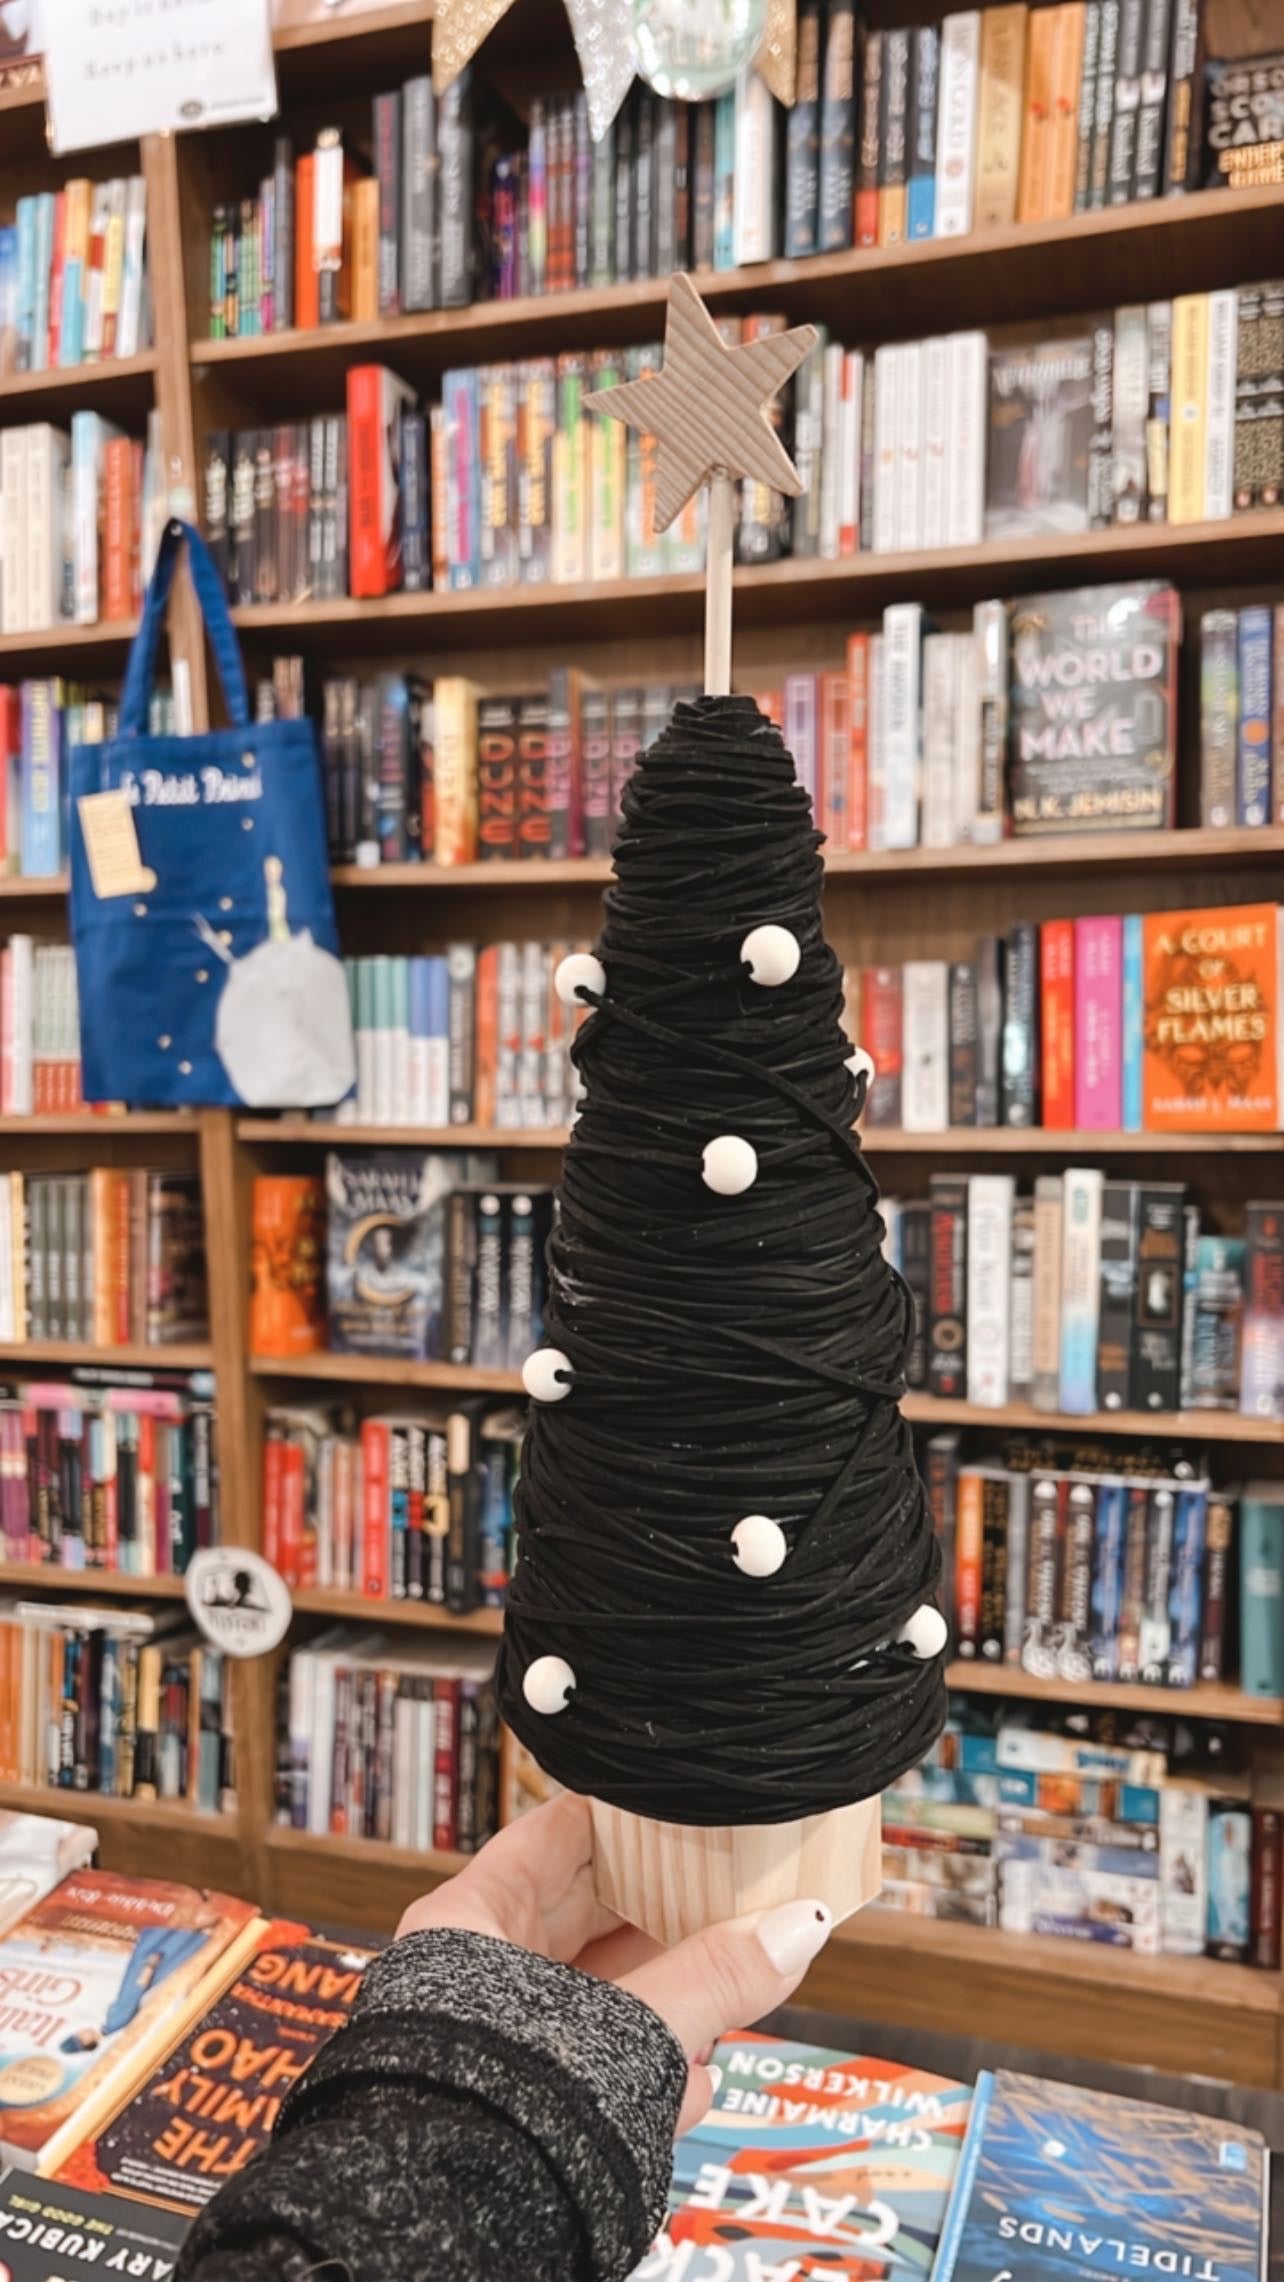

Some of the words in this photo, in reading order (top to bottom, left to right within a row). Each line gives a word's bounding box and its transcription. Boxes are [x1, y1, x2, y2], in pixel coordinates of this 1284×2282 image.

[1209, 93, 1284, 123] SCO
[1069, 611, 1129, 641] THE
[1014, 644, 1164, 689] WORLD
[1038, 686, 1098, 721] WE
[1020, 716, 1137, 762] MAKE
[141, 768, 200, 806] Petit
[480, 733, 516, 844] DUNE
[1067, 787, 1165, 817] JEMISIN
[1153, 932, 1175, 957] A
[1181, 922, 1268, 956] COURT
[1198, 957, 1226, 981] OF
[1165, 982, 1259, 1014] SILVER
[1157, 1013, 1267, 1044] FLAMES
[250, 1952, 363, 2004] ANG
[190, 2028, 315, 2088] HAO
[152, 2068, 281, 2132] MILY
[727, 2050, 946, 2119] WILKERSON
[721, 2088, 934, 2152] CHARMAINE
[153, 2116, 257, 2175] THE
[687, 2162, 900, 2245] CAKE
[105, 2247, 174, 2281] ARY
[633, 2231, 850, 2282] ACK
[997, 2216, 1222, 2282] TIDELANDS
